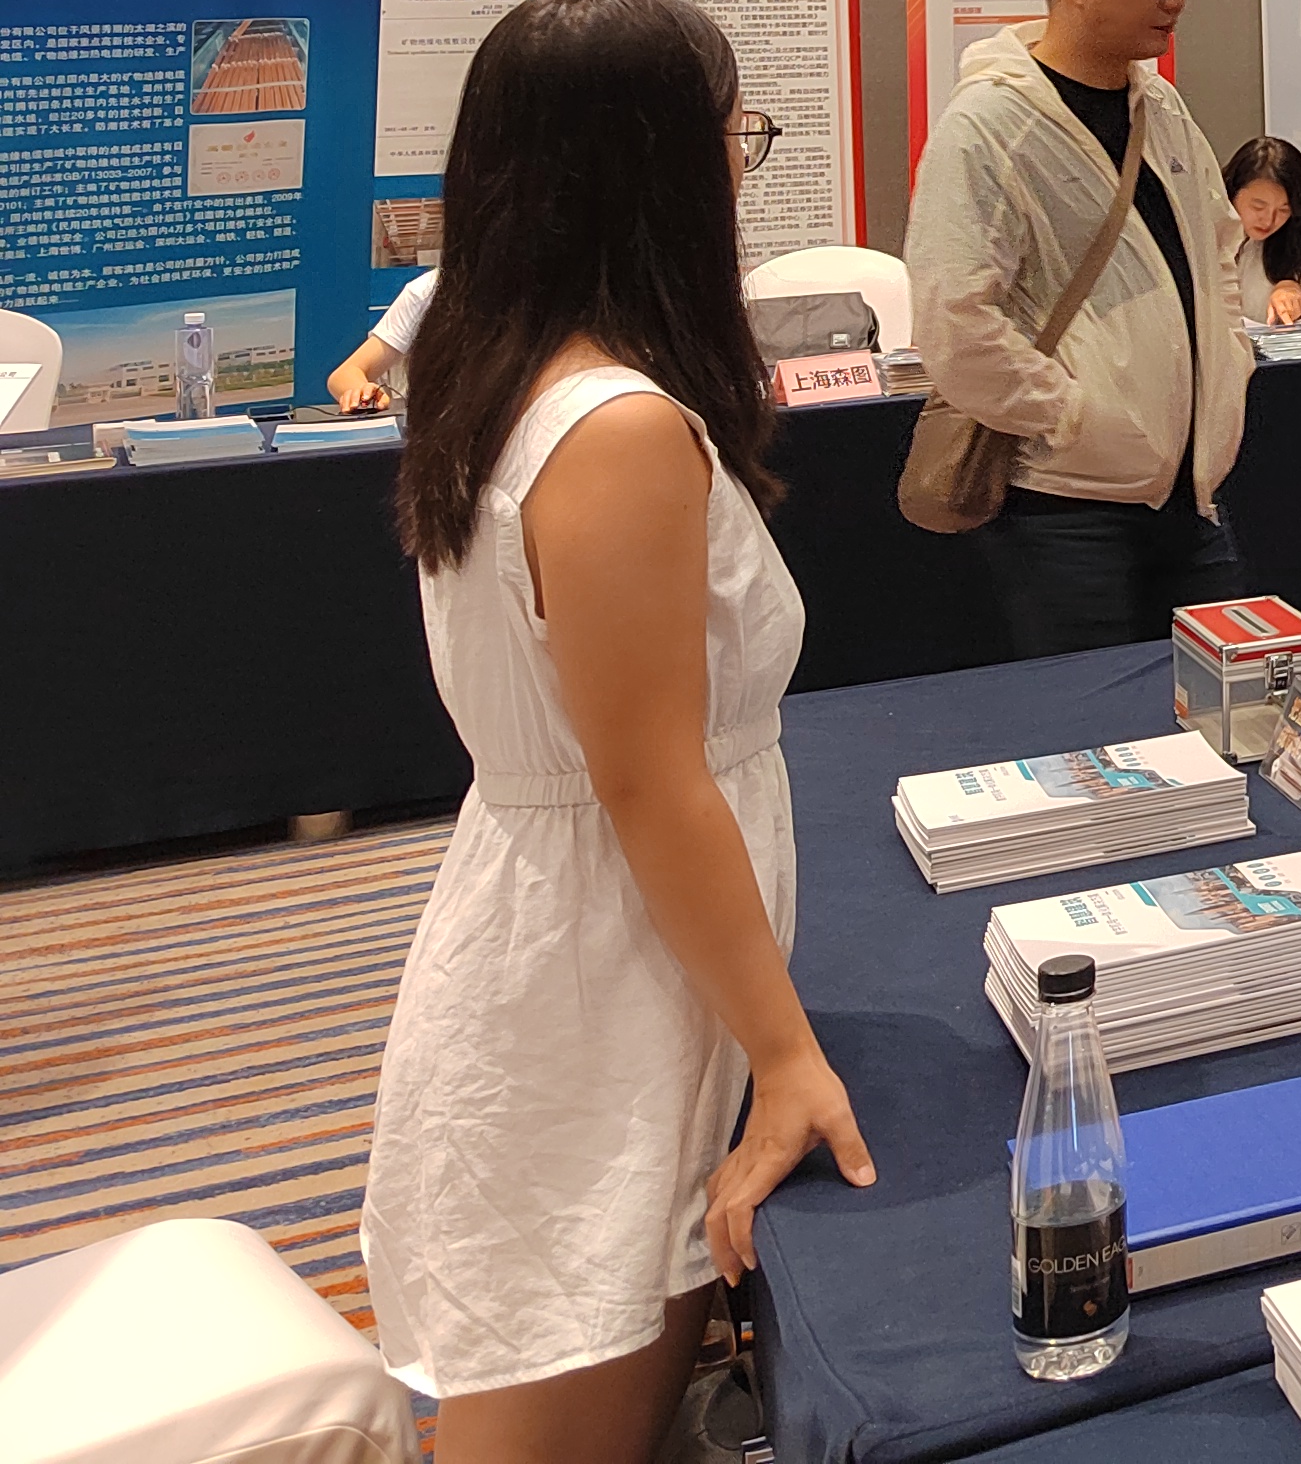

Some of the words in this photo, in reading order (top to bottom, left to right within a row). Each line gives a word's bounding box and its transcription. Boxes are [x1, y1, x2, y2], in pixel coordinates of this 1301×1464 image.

[791, 364, 872, 393] 上海森图
[1028, 1251, 1099, 1274] GOLDEN
